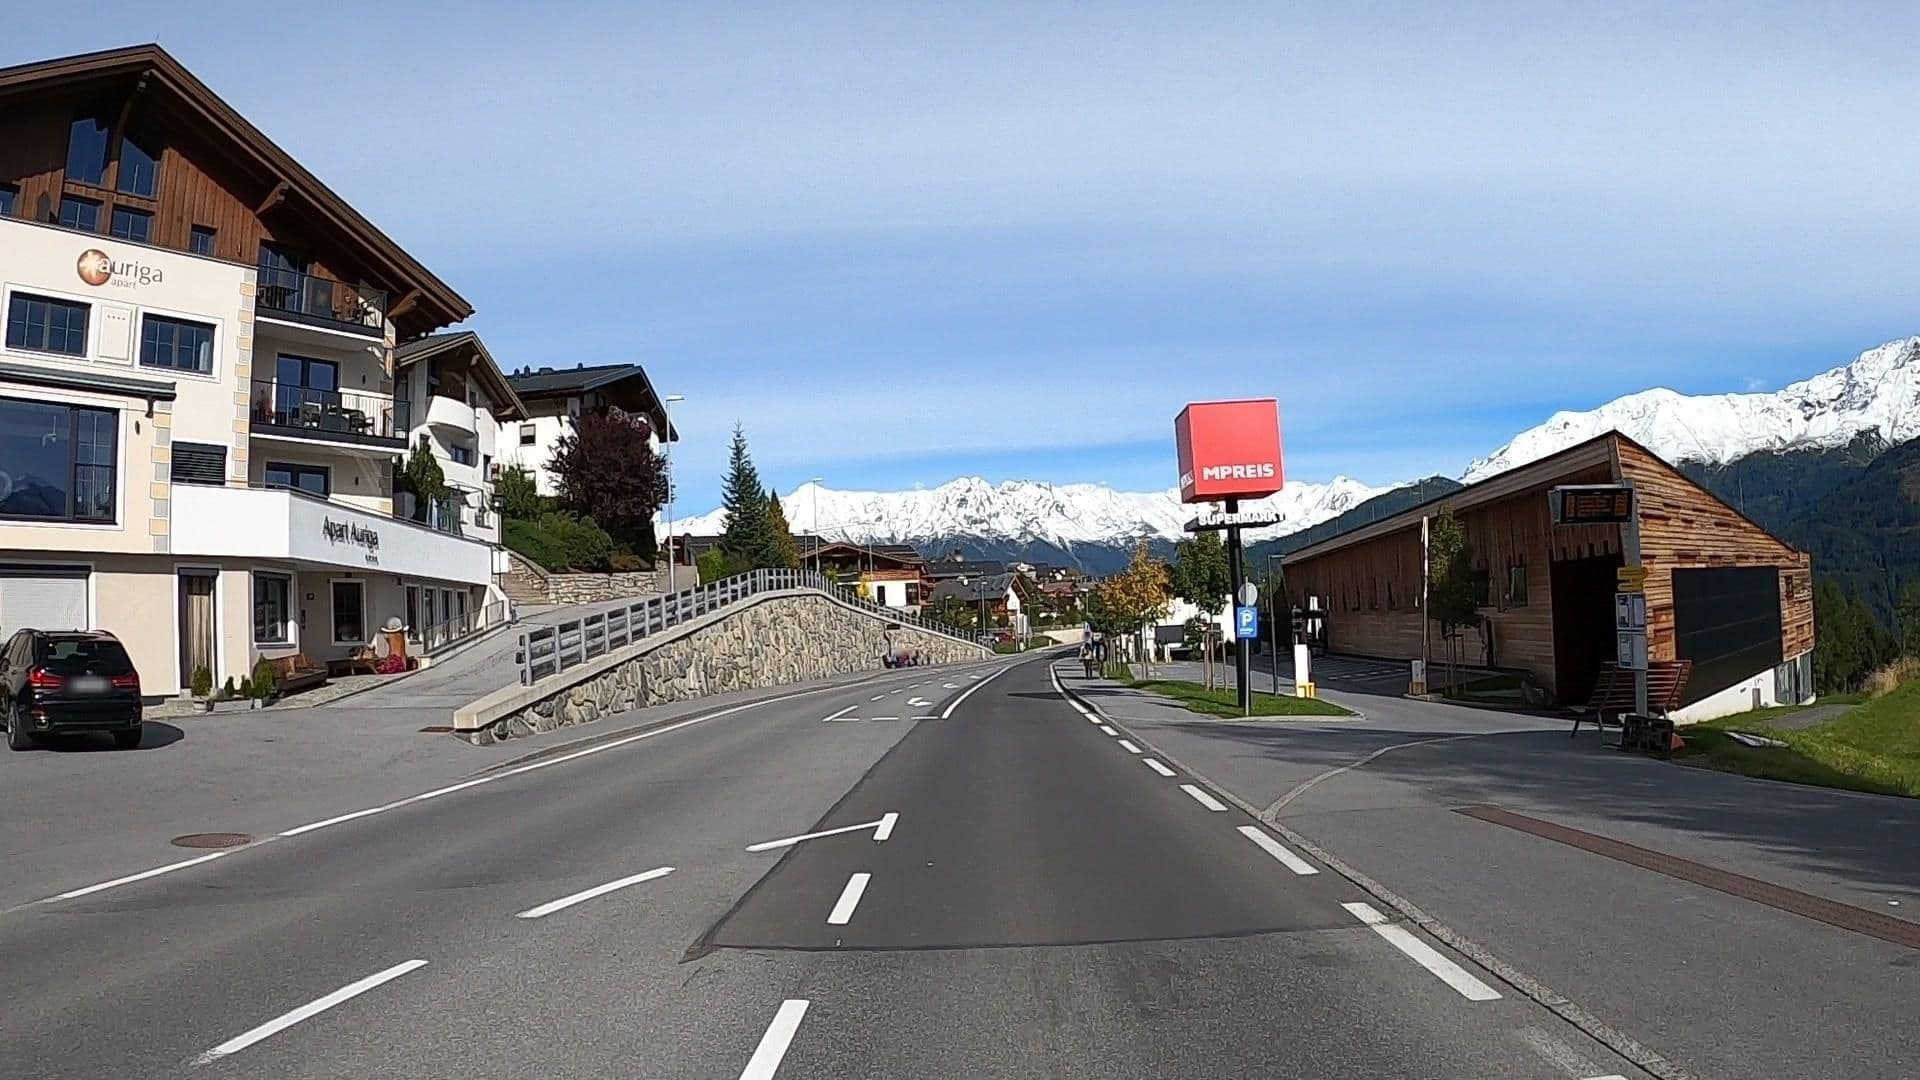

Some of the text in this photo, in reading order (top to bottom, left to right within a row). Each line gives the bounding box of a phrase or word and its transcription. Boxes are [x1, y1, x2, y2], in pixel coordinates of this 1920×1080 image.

[99, 258, 163, 286] auriga
[111, 278, 137, 289] apart
[1203, 463, 1275, 481] MPREIS
[323, 515, 379, 554] Apart Auriga
[1242, 613, 1253, 626] P
